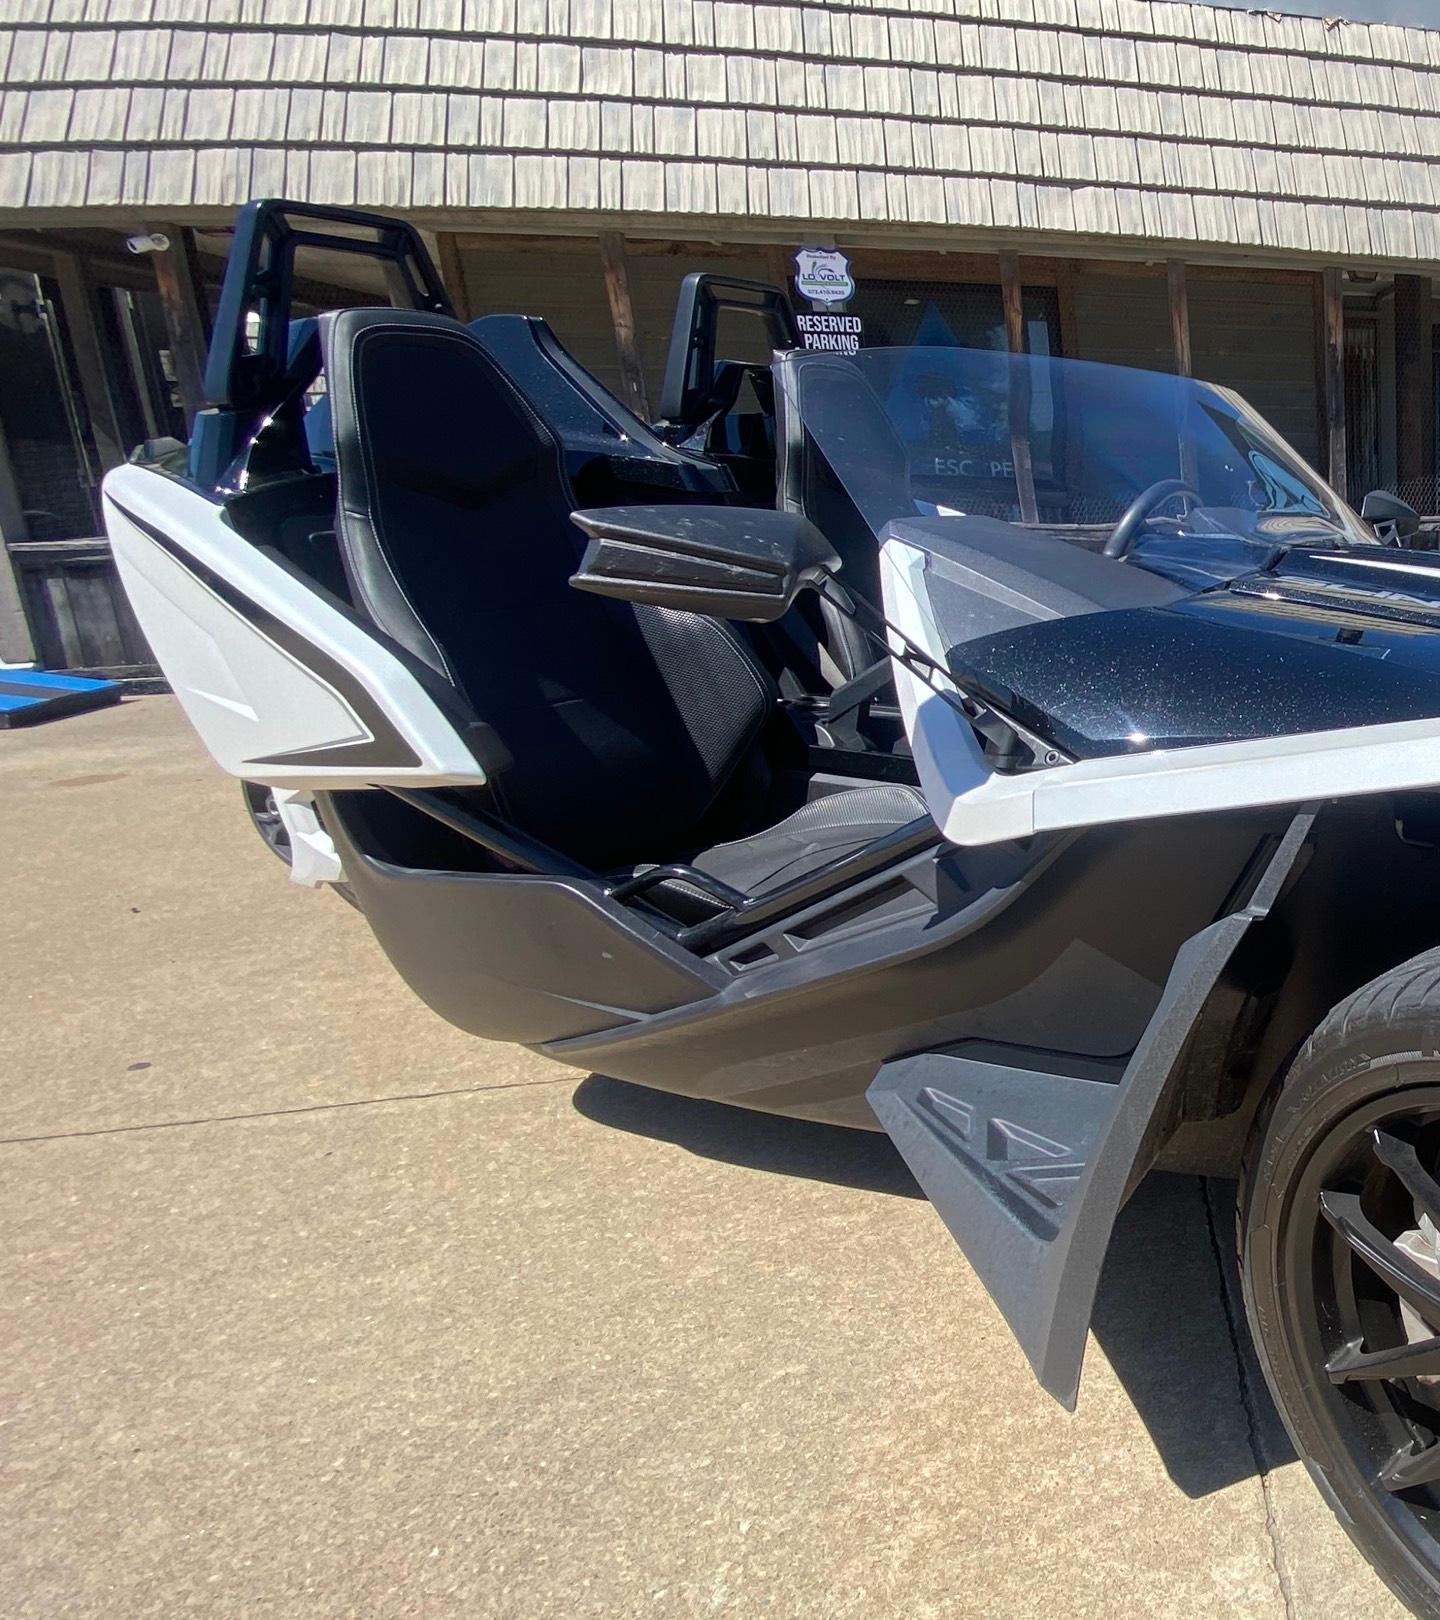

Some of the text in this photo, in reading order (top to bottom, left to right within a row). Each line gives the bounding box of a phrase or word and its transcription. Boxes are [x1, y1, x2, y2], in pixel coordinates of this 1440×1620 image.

[820, 274, 846, 282] VOLT
[797, 315, 862, 333] RESERVED
[804, 333, 860, 351] PARKING
